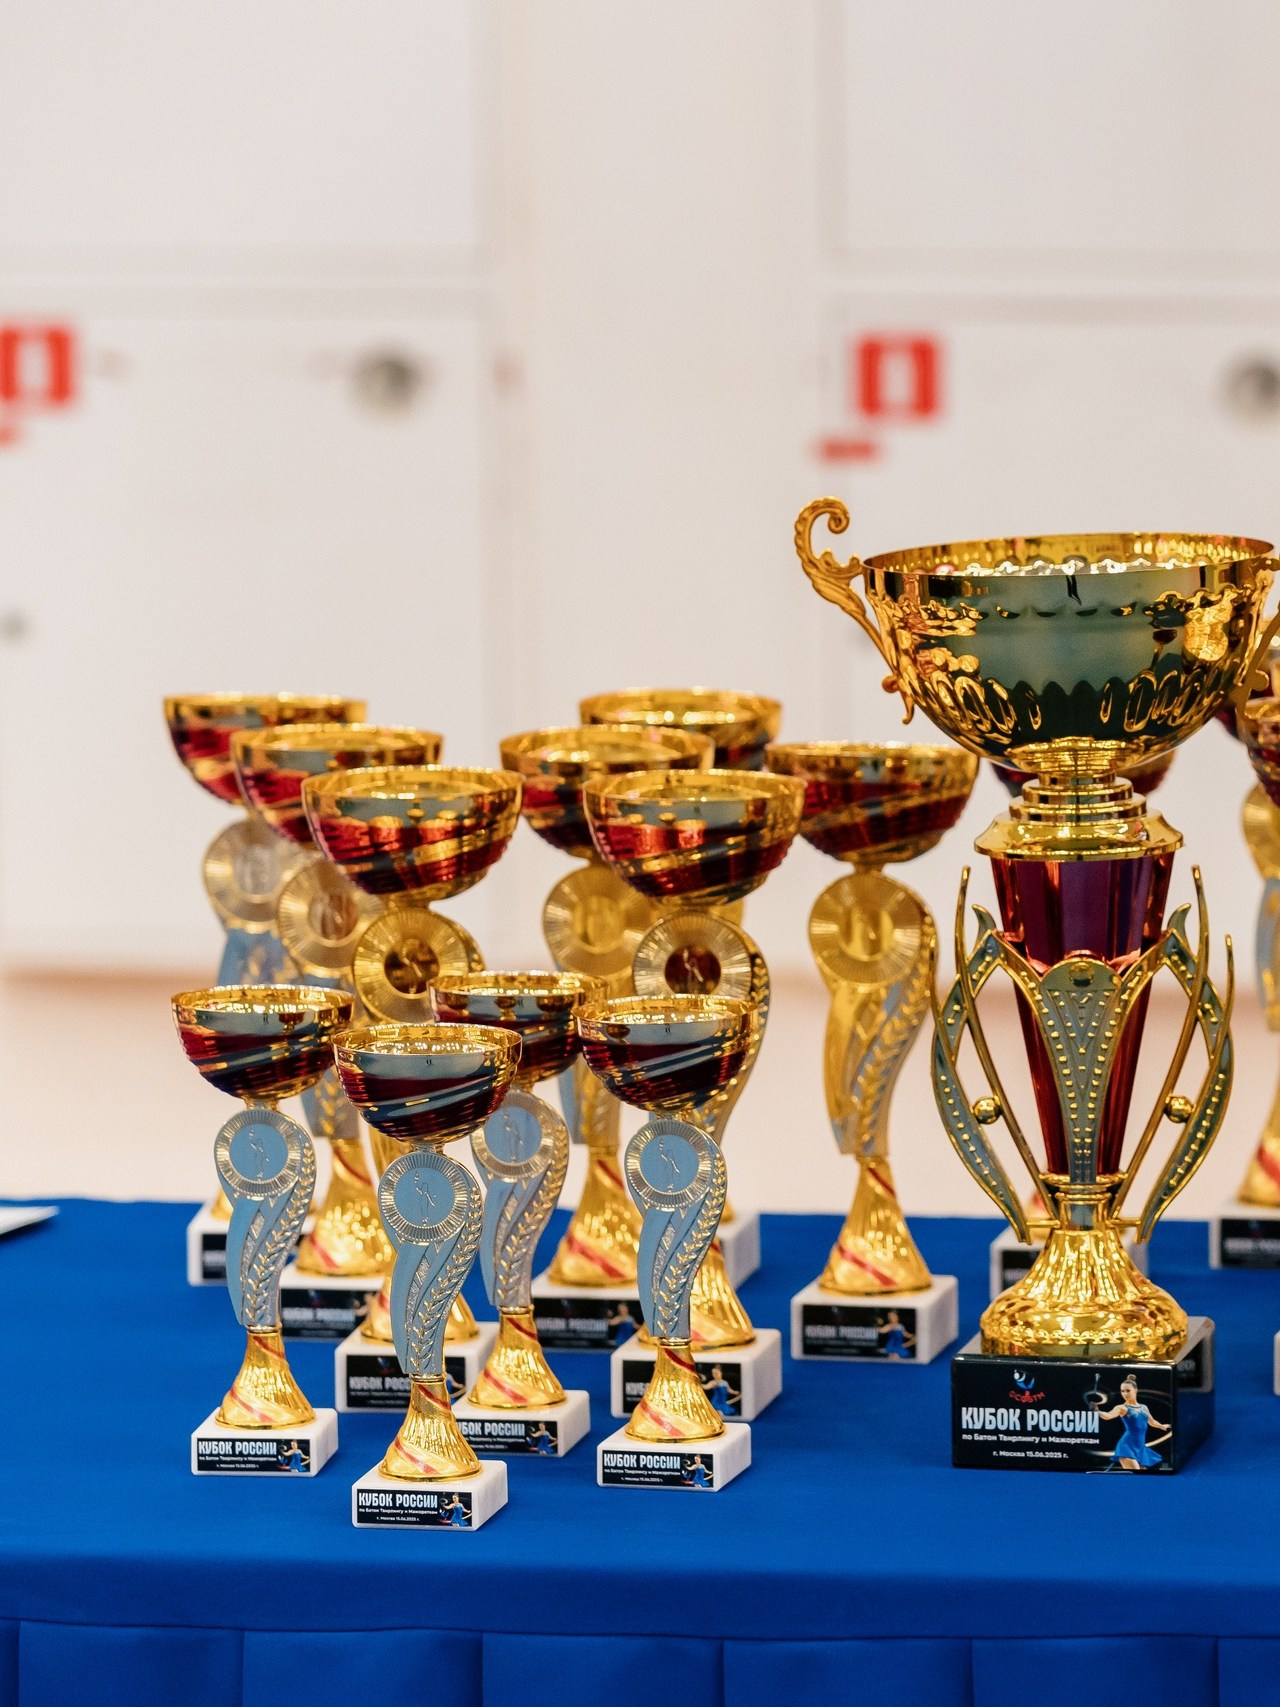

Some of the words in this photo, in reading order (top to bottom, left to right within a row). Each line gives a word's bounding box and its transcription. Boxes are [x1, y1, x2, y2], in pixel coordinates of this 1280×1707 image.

[961, 1407, 1021, 1431] КУБОК
[1027, 1409, 1099, 1433] РОССИИ
[458, 1422, 482, 1436] БОК
[484, 1422, 525, 1436] РОССИИ
[974, 1433, 997, 1441] Батон
[998, 1434, 1040, 1444] Твирлингу
[1048, 1436, 1100, 1444] Мажореткам
[198, 1441, 232, 1455] КУБОК
[235, 1441, 277, 1455] РОССИИ
[604, 1453, 637, 1467] КУБОК
[639, 1455, 680, 1470] РОССИИ
[359, 1492, 393, 1507] КУБОК
[396, 1494, 438, 1508] РОССИИ
